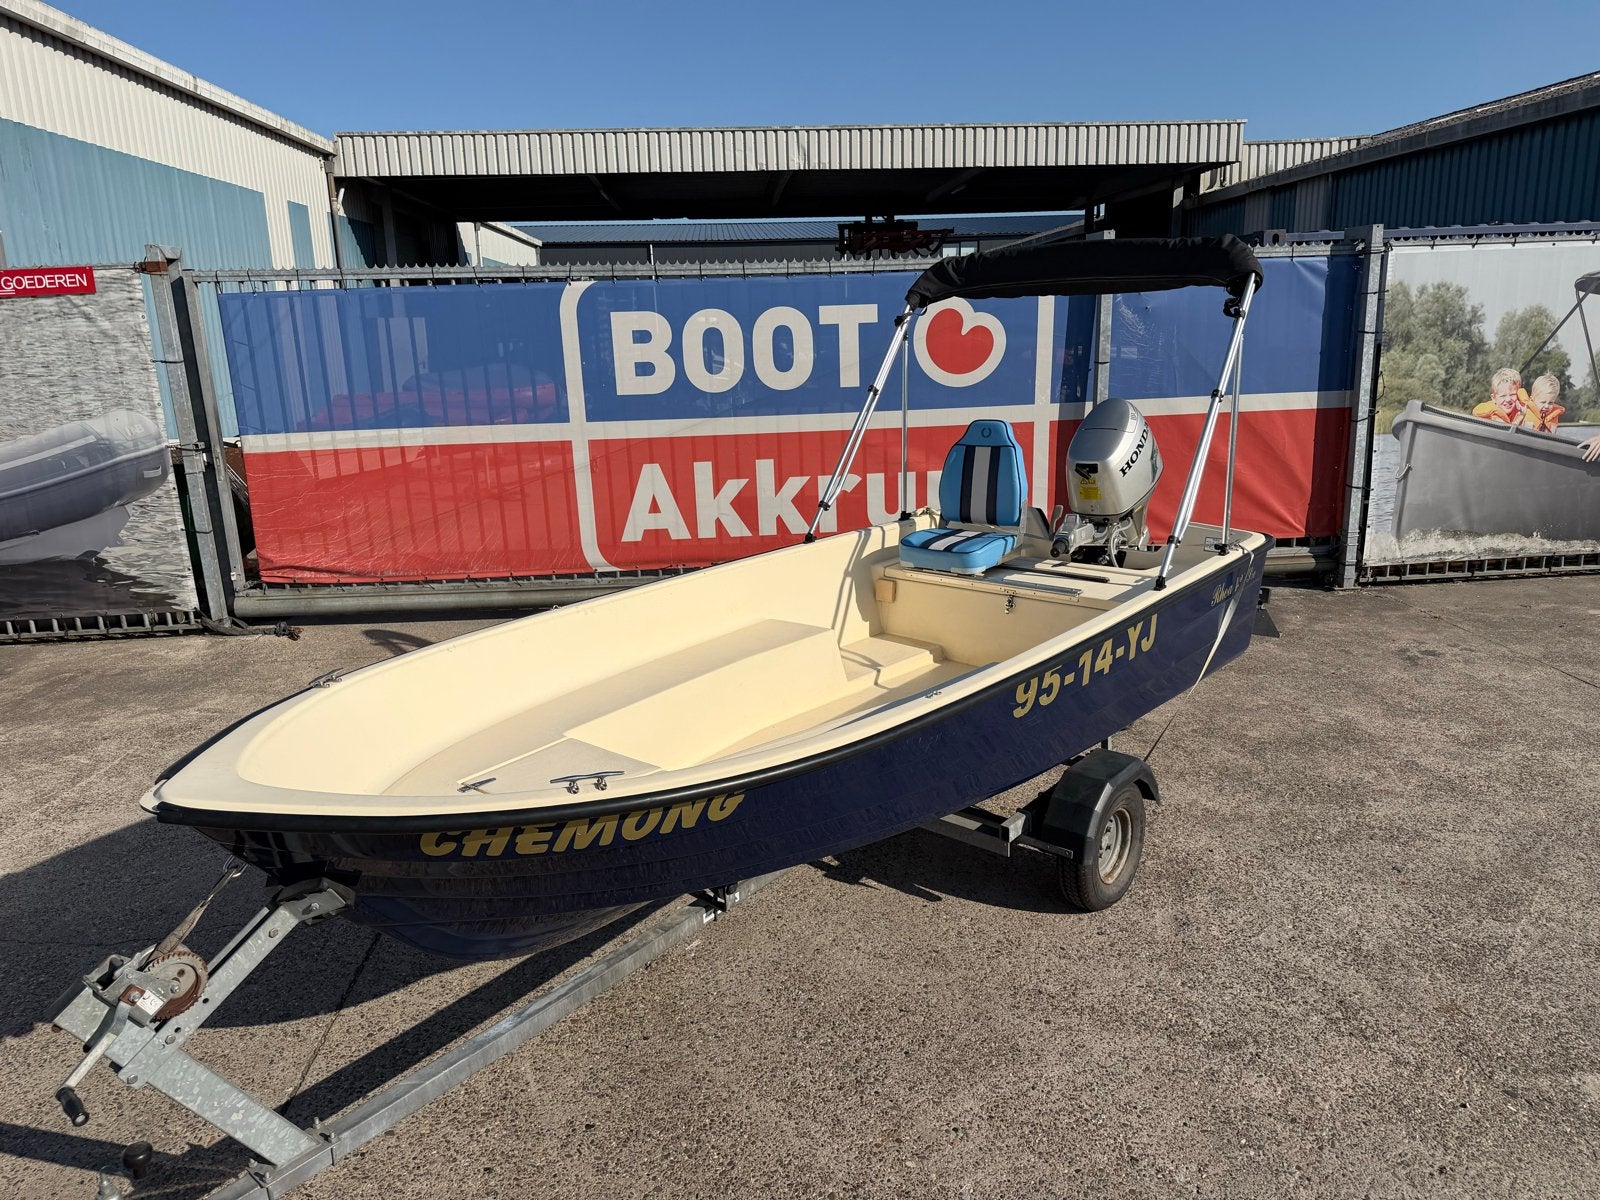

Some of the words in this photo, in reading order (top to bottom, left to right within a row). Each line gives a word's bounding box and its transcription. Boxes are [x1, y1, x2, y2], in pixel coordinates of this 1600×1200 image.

[0, 273, 88, 290] GOEDEREN
[609, 303, 878, 396] BOOT
[620, 458, 943, 544] Akkru
[1012, 613, 1159, 719] 95-14-YJ
[419, 790, 745, 857] CHEMONG
